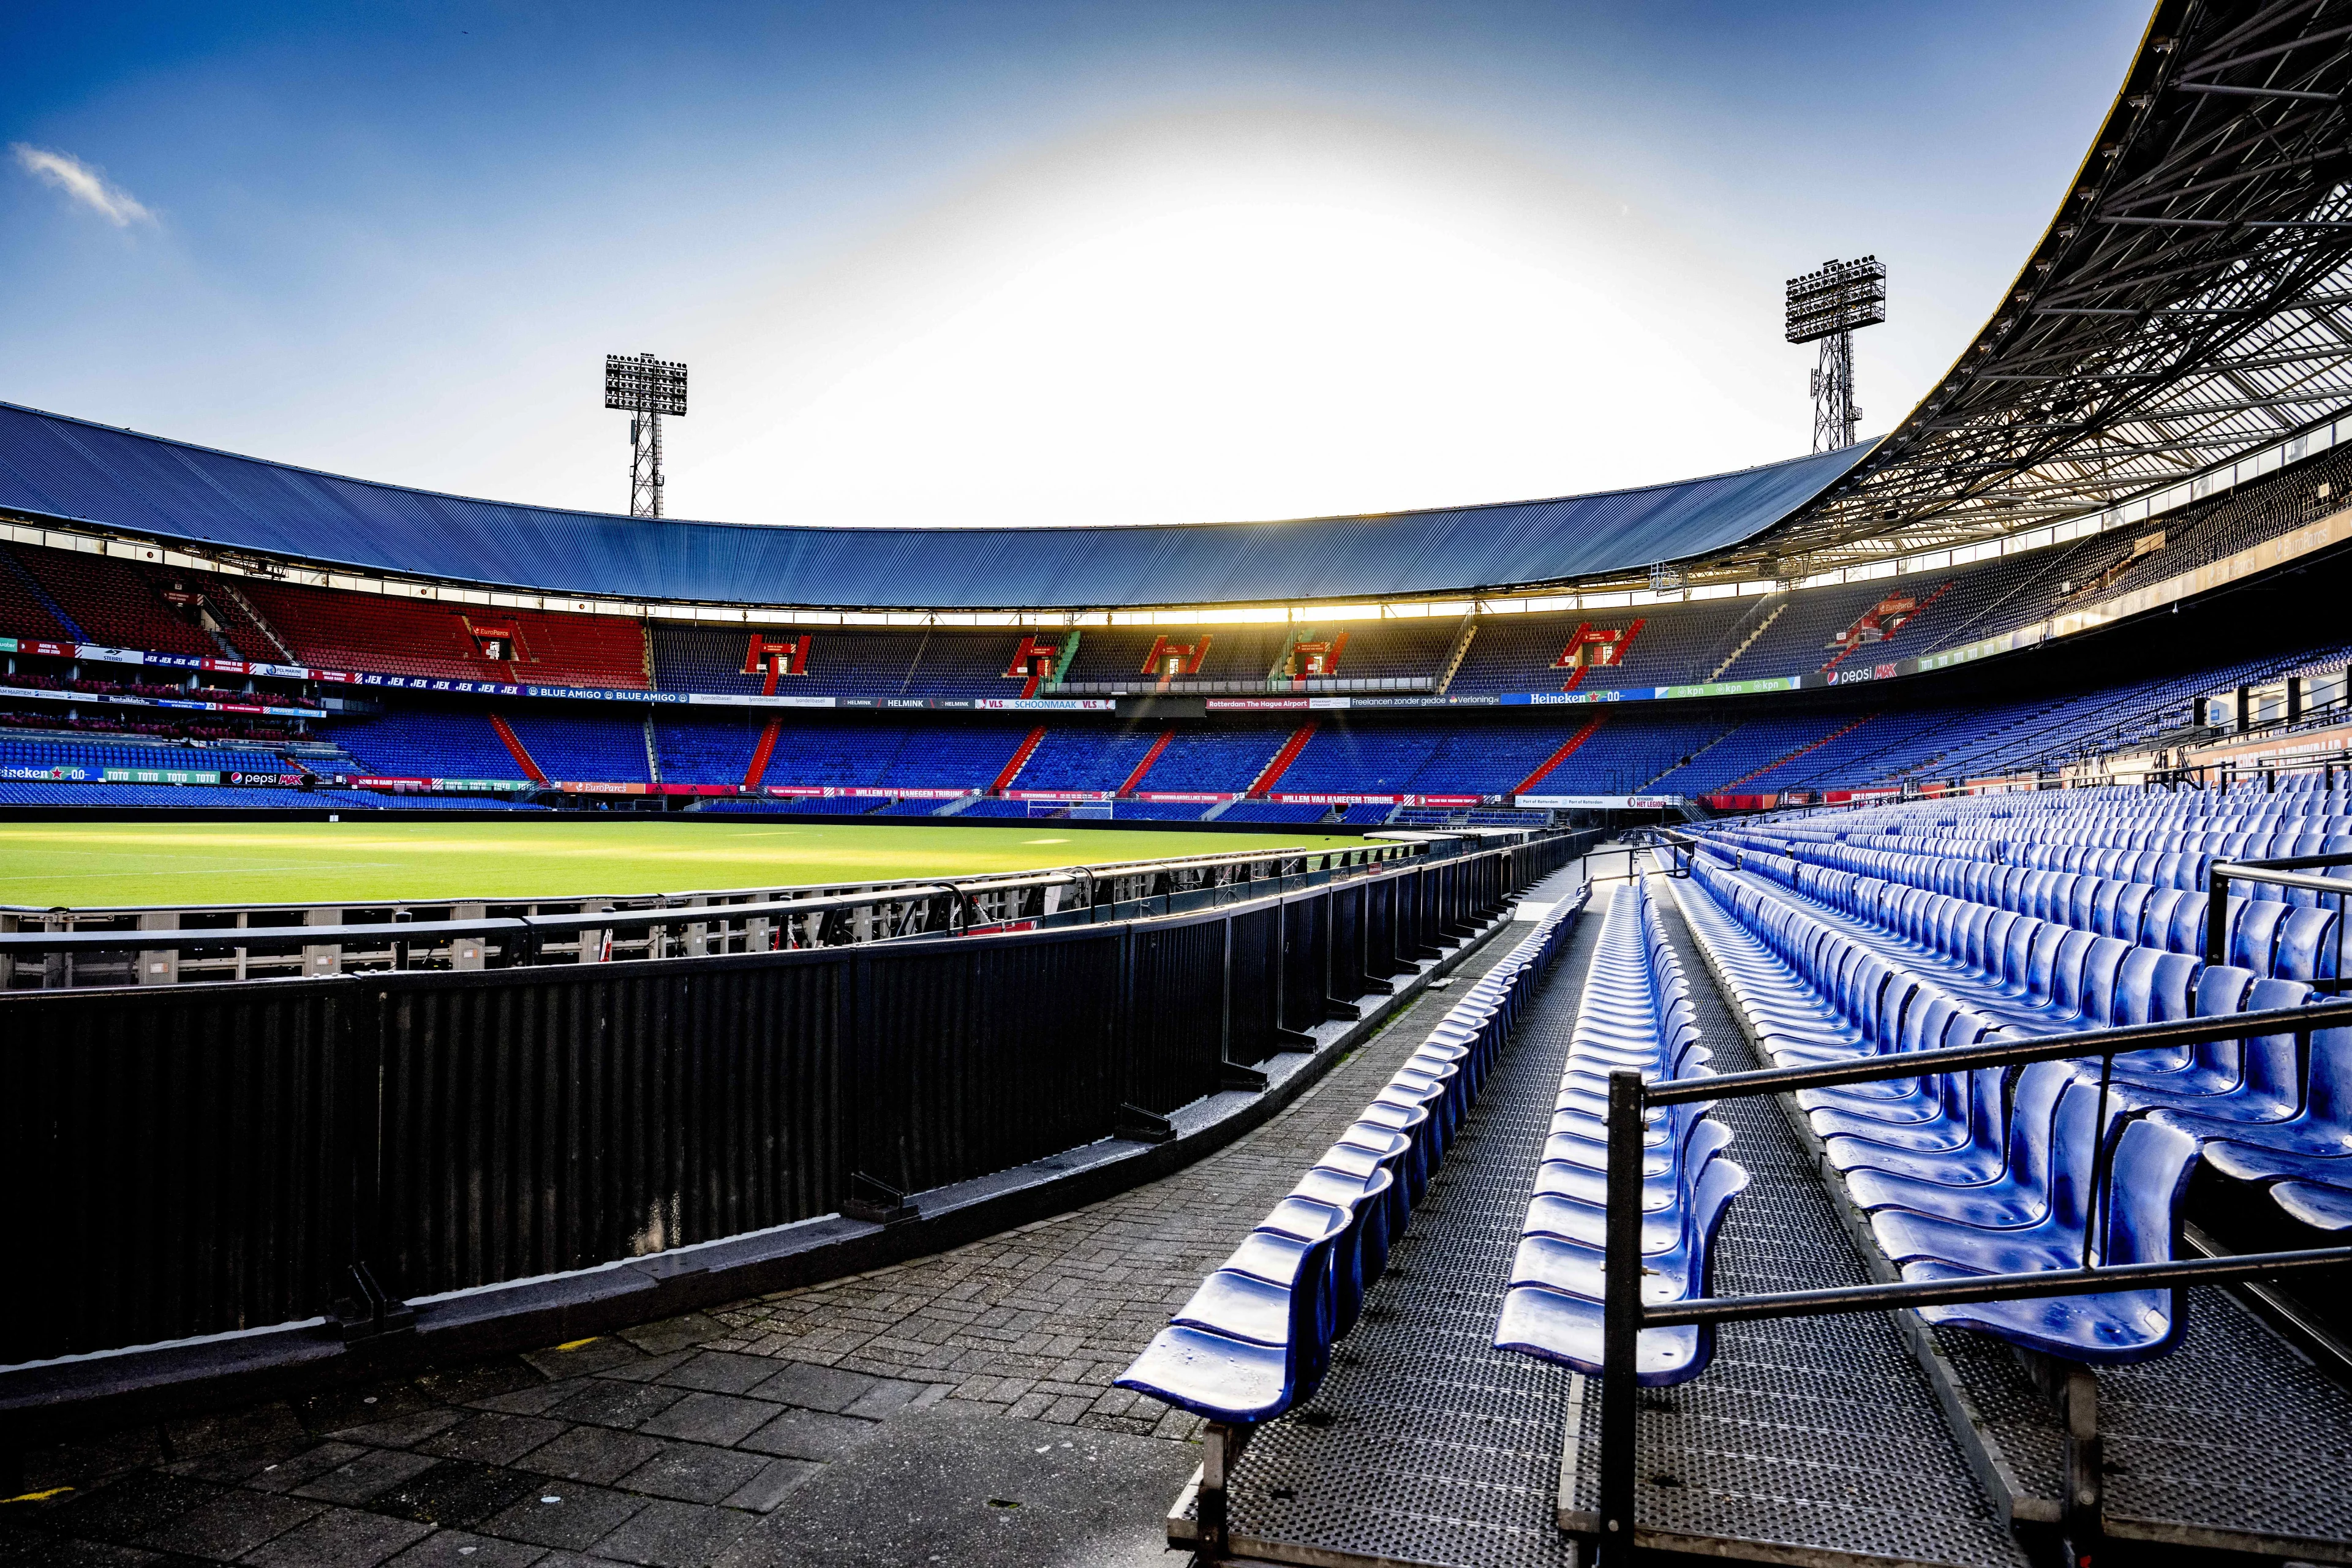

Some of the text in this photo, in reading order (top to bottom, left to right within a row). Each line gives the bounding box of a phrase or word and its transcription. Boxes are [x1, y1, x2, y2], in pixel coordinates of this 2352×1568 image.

[2283, 528, 2328, 557] EuroParcs
[2216, 556, 2255, 579] EuroParcs
[1886, 602, 1913, 611] EuroParcs
[1984, 644, 1994, 655] TOTO
[1999, 639, 2010, 650] TOTO
[1954, 652, 1964, 663] TOTO
[1968, 648, 1977, 659] TOTO
[1921, 659, 1932, 670] TOTO
[1938, 655, 1948, 666] TOTO
[1841, 662, 1898, 684] pepsi MAX
[365, 676, 382, 684] JEX
[388, 677, 404, 686] JEX
[410, 679, 427, 688] JEX
[433, 681, 450, 690] JEX
[1763, 680, 1779, 690] kpn
[478, 684, 495, 693] JEX
[1687, 687, 1704, 696] kpn
[1725, 684, 1742, 693] kpn
[1422, 697, 1446, 706] gedoe
[1531, 693, 1586, 704] Heineken
[107, 772, 215, 783] TOTO TOTO TOTO TOTO
[245, 774, 304, 785] pepsi MAX
[585, 783, 627, 792] EuroParcs
